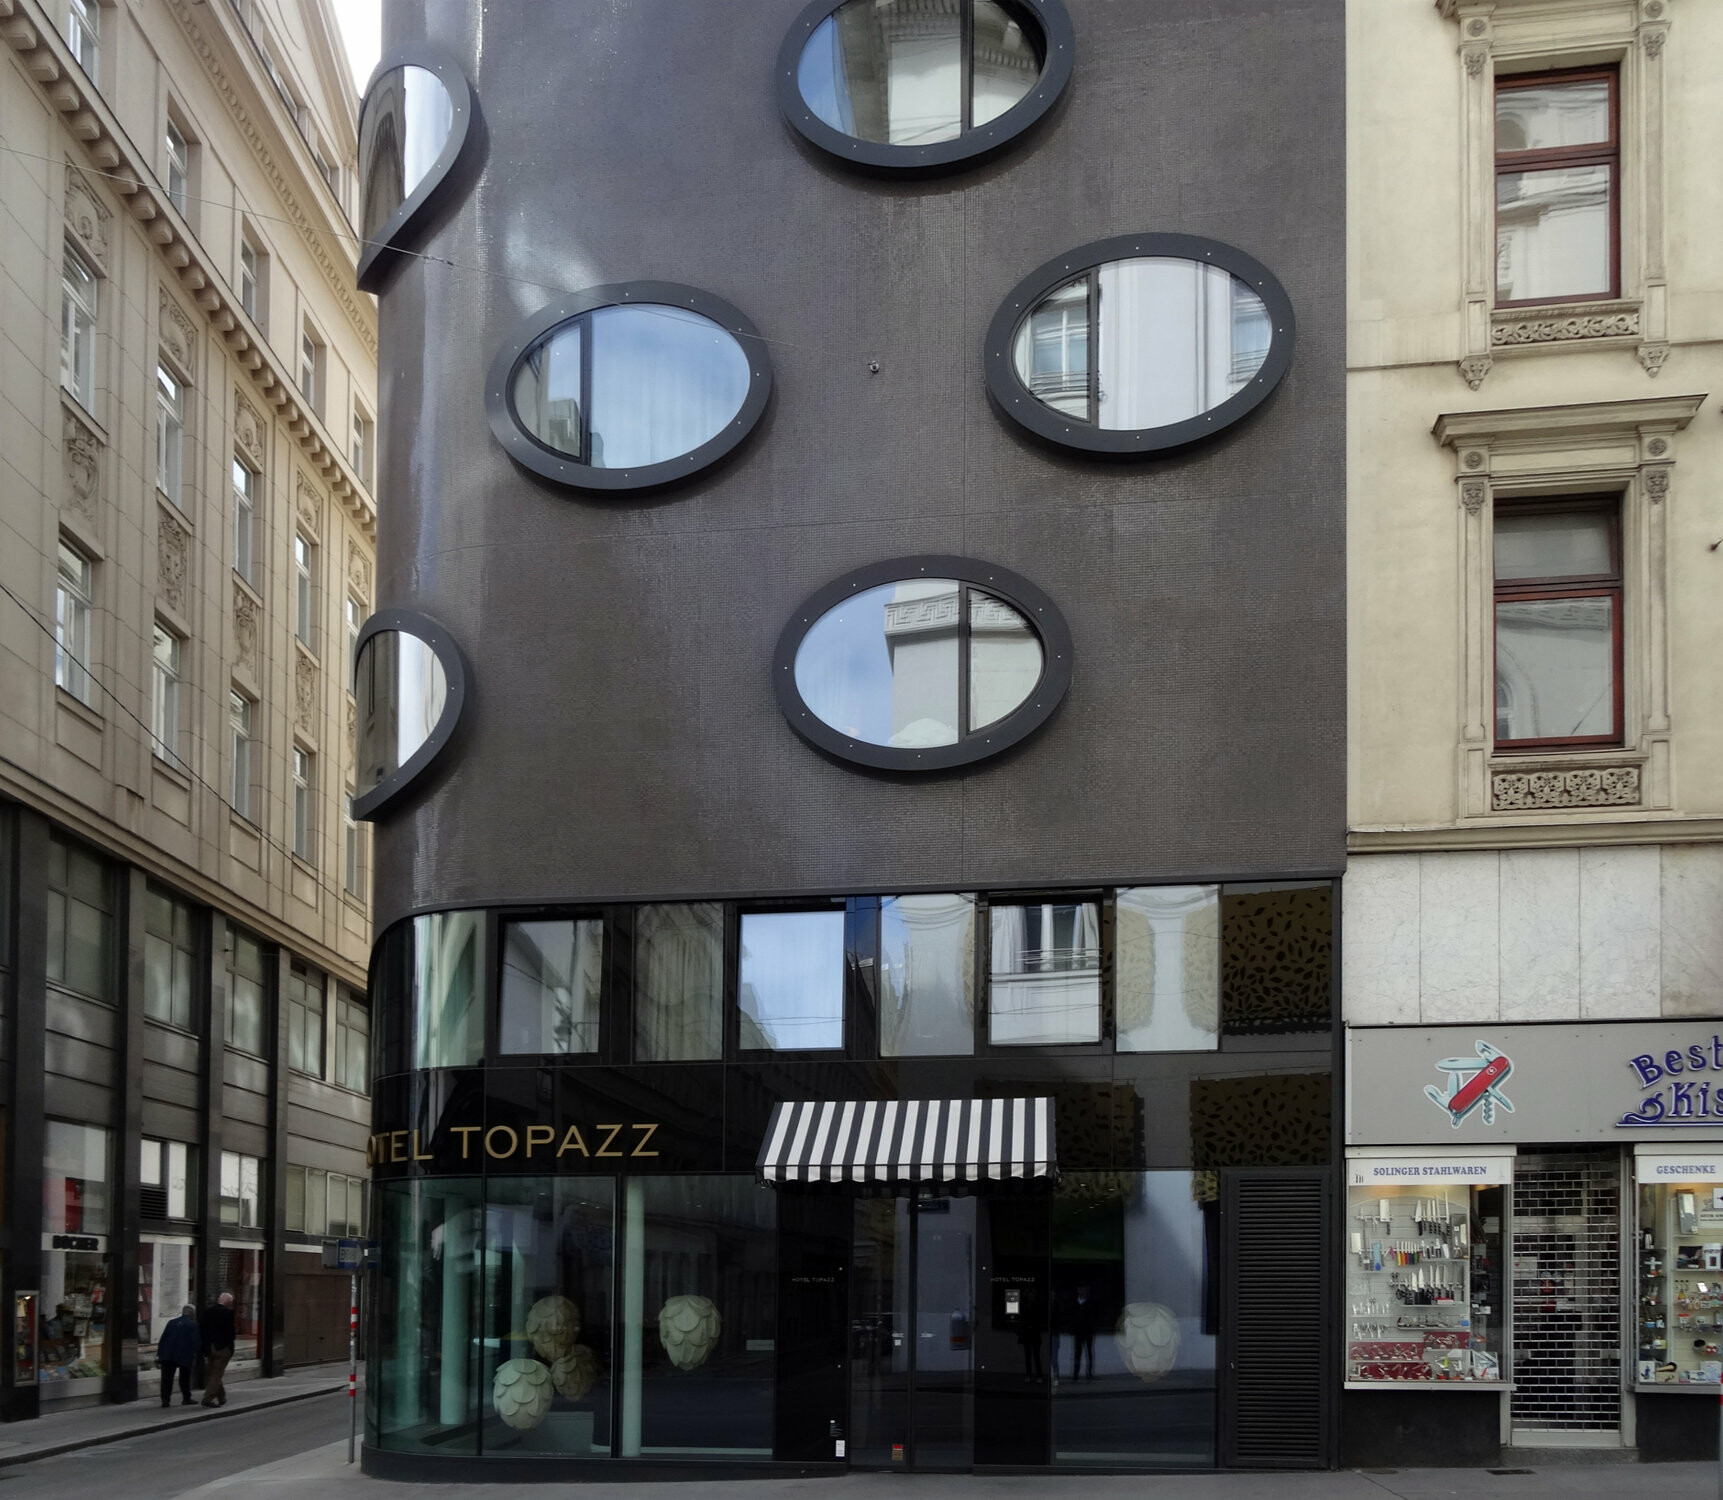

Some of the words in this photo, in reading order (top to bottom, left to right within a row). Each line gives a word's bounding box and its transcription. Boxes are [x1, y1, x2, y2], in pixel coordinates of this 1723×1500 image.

[450, 1124, 660, 1159] TOPAZZ
[1373, 1166, 1421, 1177] SOLINGER
[1422, 1166, 1487, 1176] STAHLWAREN
[1656, 1165, 1717, 1175] GESCHENKE
